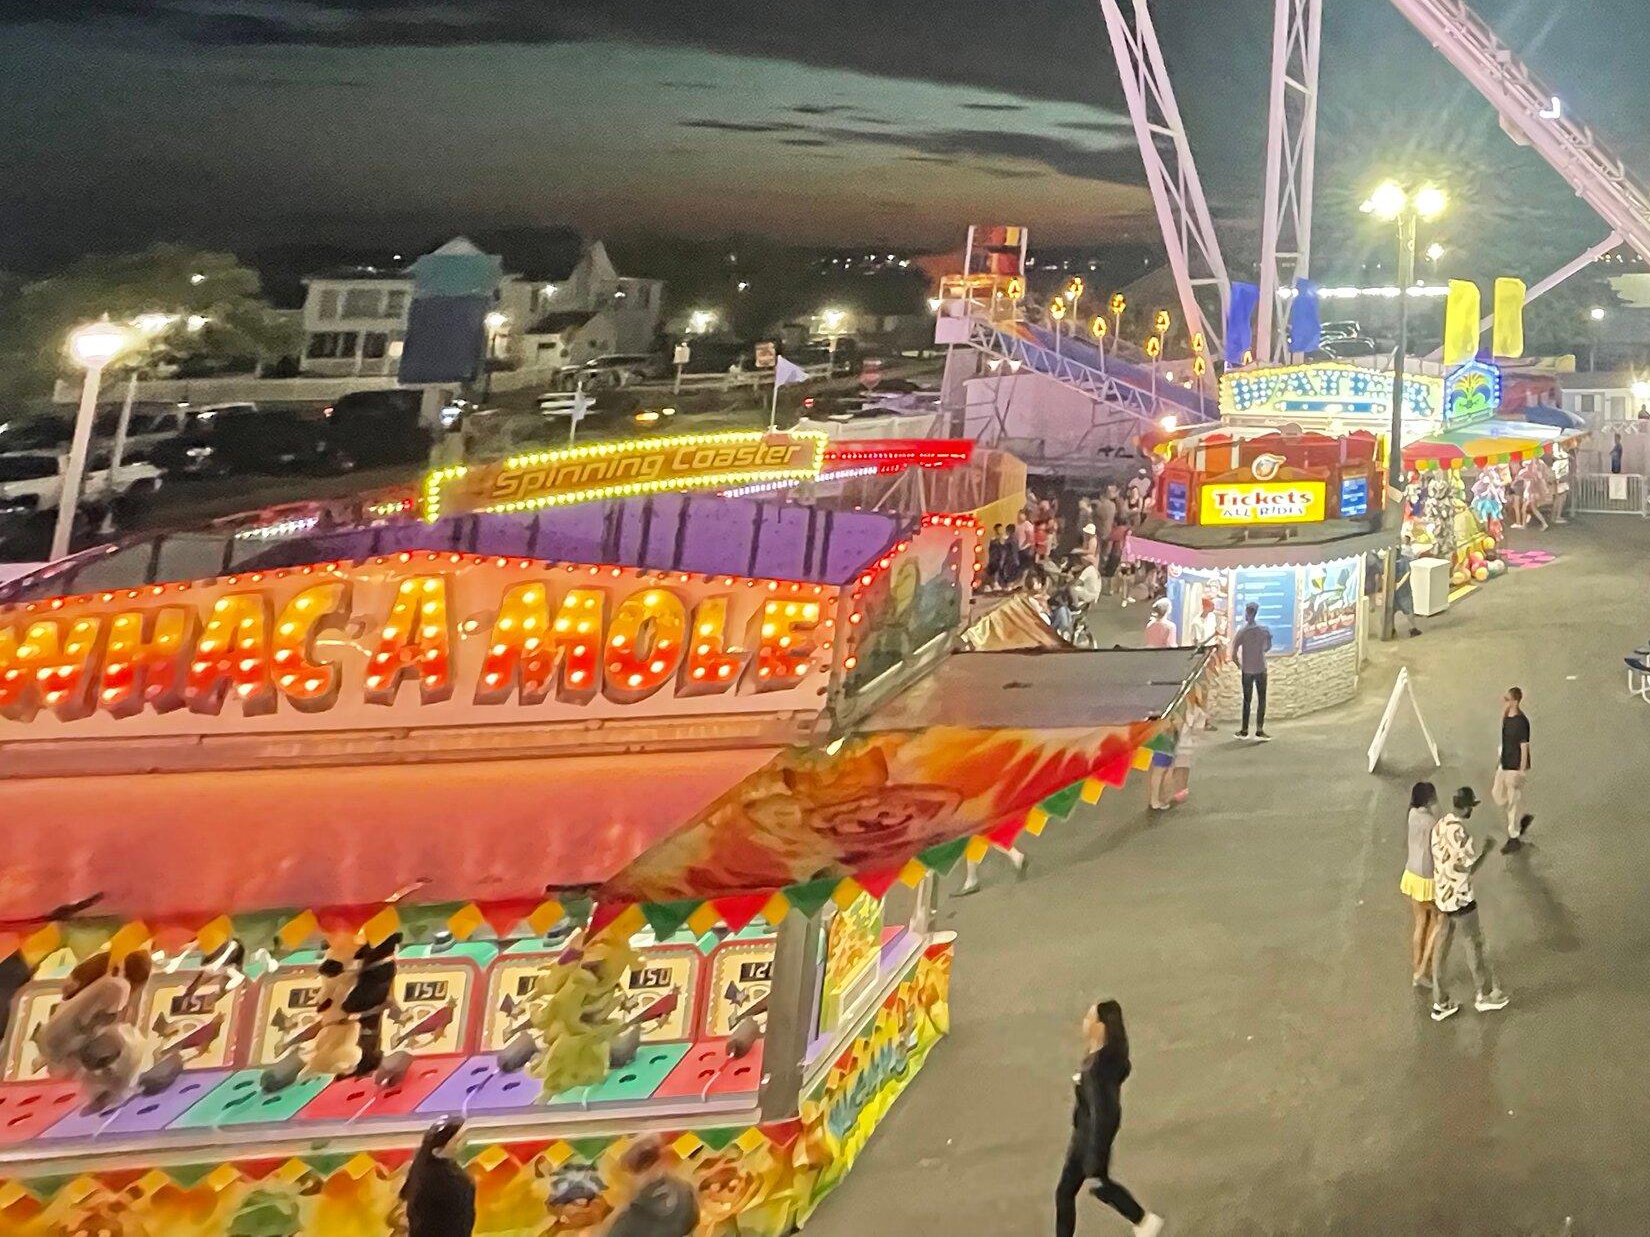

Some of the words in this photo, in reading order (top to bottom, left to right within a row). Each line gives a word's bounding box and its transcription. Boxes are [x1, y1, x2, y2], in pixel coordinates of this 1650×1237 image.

[495, 452, 662, 497] Spinning
[672, 442, 801, 477] Coaster
[1215, 492, 1311, 506] Tickets
[1223, 508, 1250, 517] ALL
[473, 581, 821, 705] MOLE
